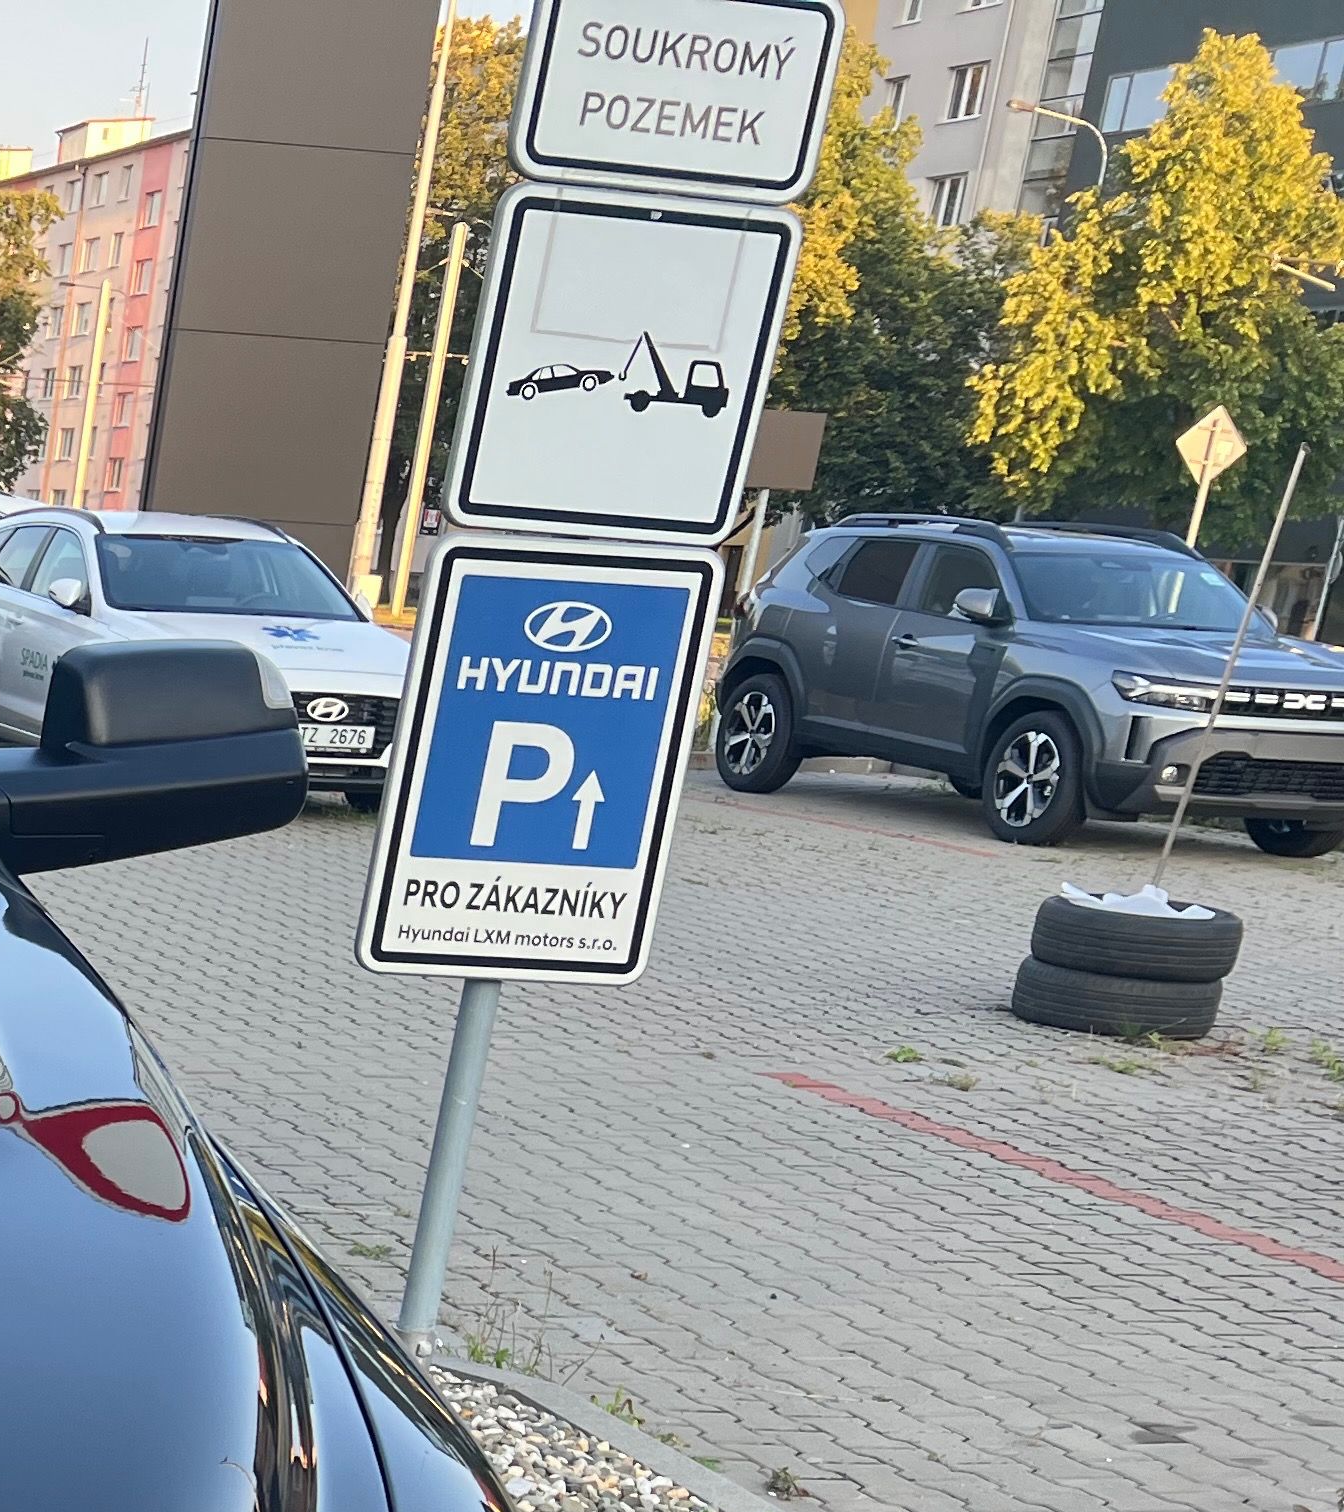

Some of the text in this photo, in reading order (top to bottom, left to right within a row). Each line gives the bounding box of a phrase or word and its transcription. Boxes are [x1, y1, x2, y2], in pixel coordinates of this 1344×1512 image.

[576, 21, 797, 81] SOUKROMÝ
[578, 91, 766, 146] POZEMEK
[457, 656, 660, 701] HYUNDAI
[329, 728, 366, 745] 2676
[470, 720, 575, 847] P
[402, 875, 628, 920] PRO ZÁKAZNÍKY
[398, 924, 618, 951] Hyundai LXM motors s.r.o.
